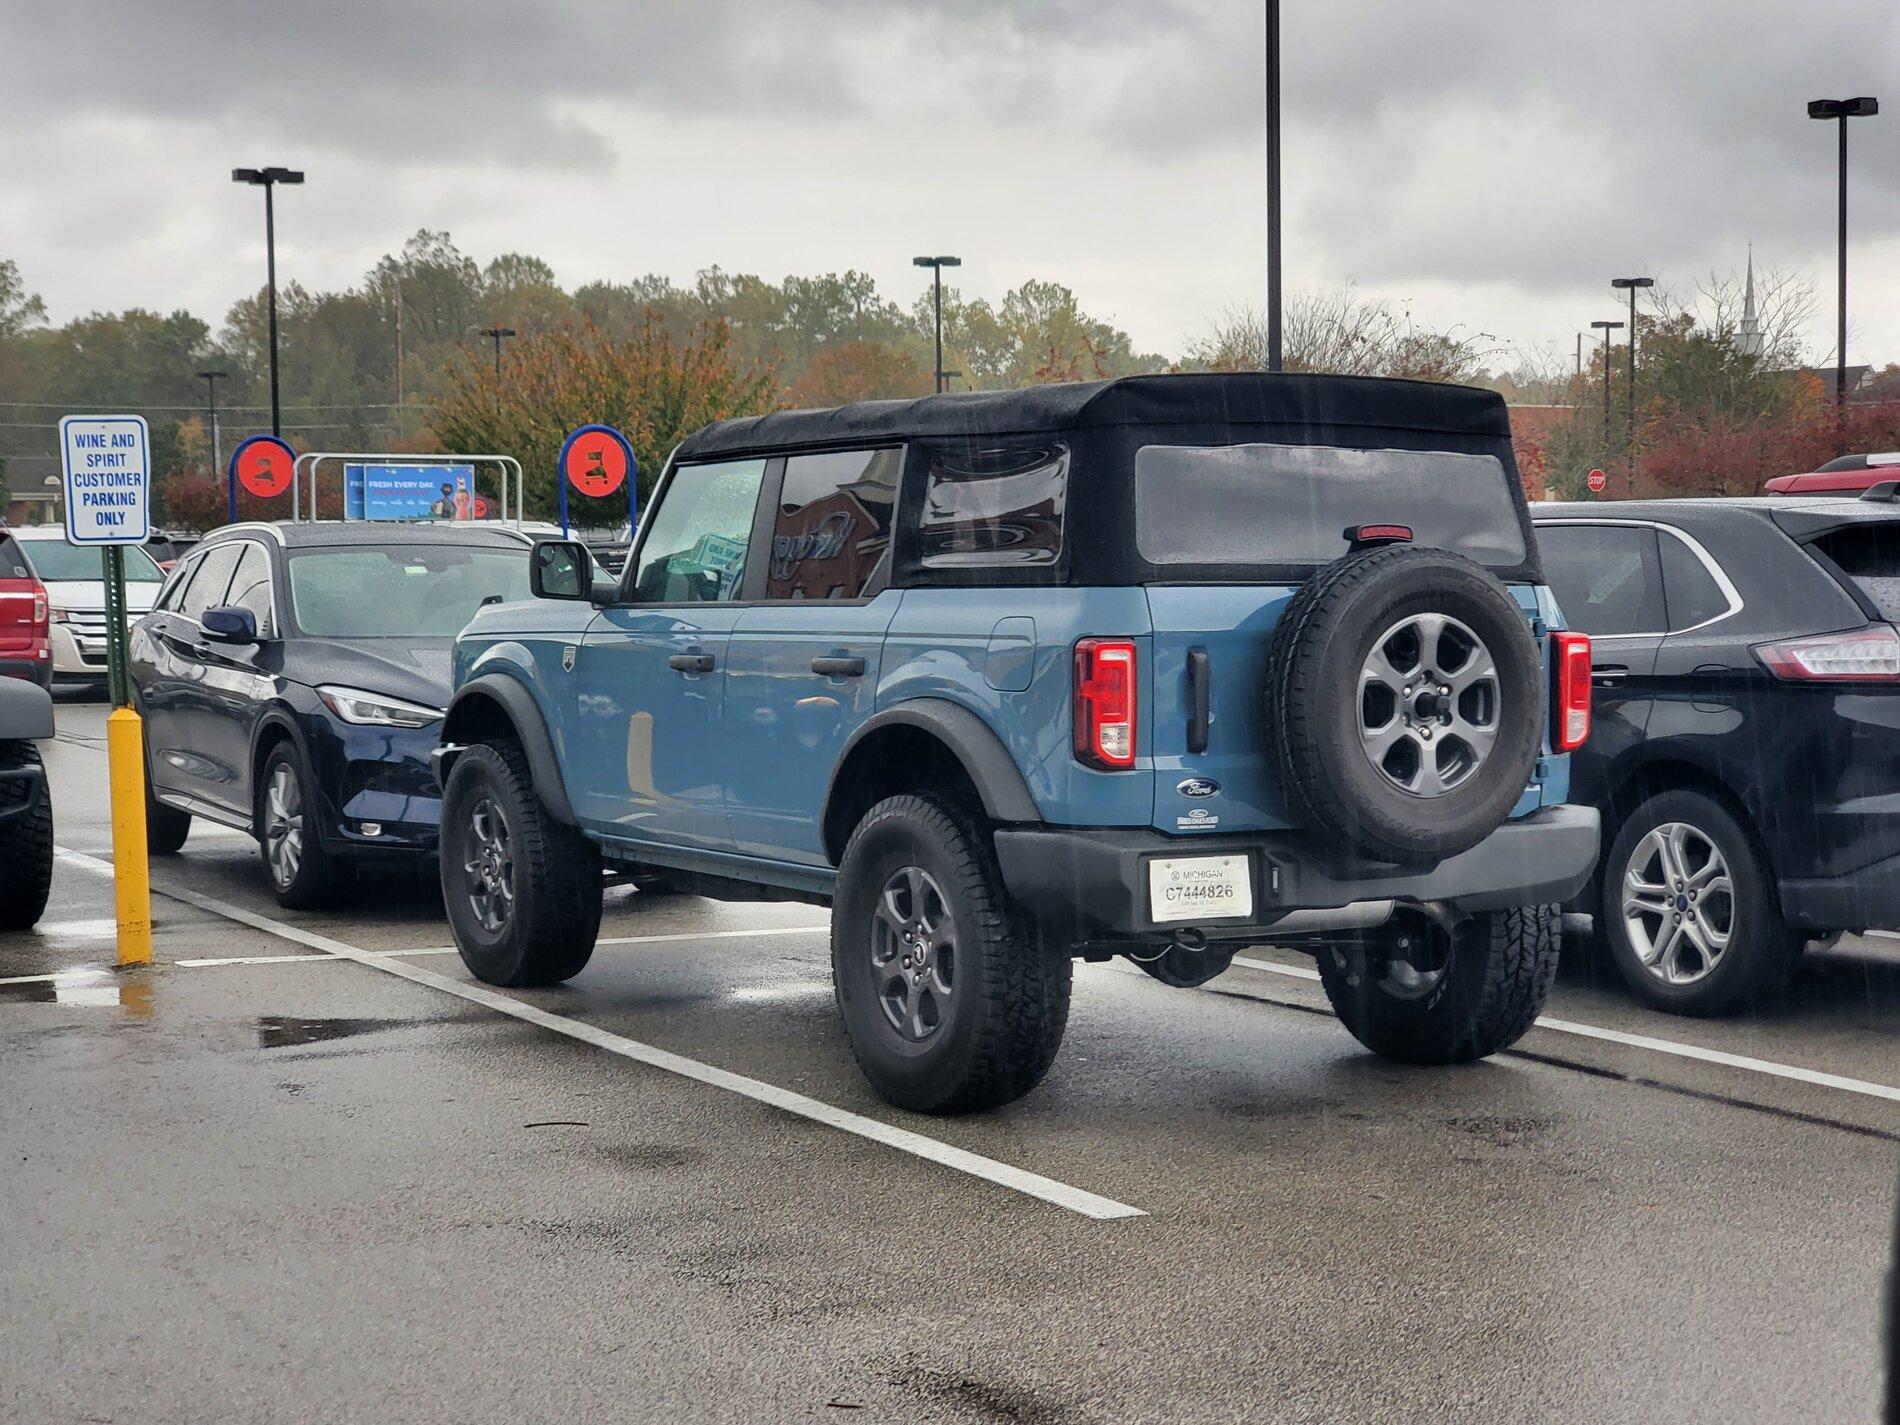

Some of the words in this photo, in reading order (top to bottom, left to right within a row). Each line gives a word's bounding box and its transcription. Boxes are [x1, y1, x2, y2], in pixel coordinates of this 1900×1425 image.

[75, 434, 107, 448] WINE
[111, 434, 135, 448] AND
[86, 453, 127, 467] SPIRIT
[74, 473, 141, 487] CUSTOMER
[369, 480, 393, 488] FRESH
[394, 480, 418, 488] EVERY
[1589, 476, 1604, 485] STOP
[83, 492, 136, 506] PARKING
[96, 512, 126, 526] ONLY
[1183, 869, 1223, 880] MICHIGAN
[1165, 884, 1234, 901] C7444826
